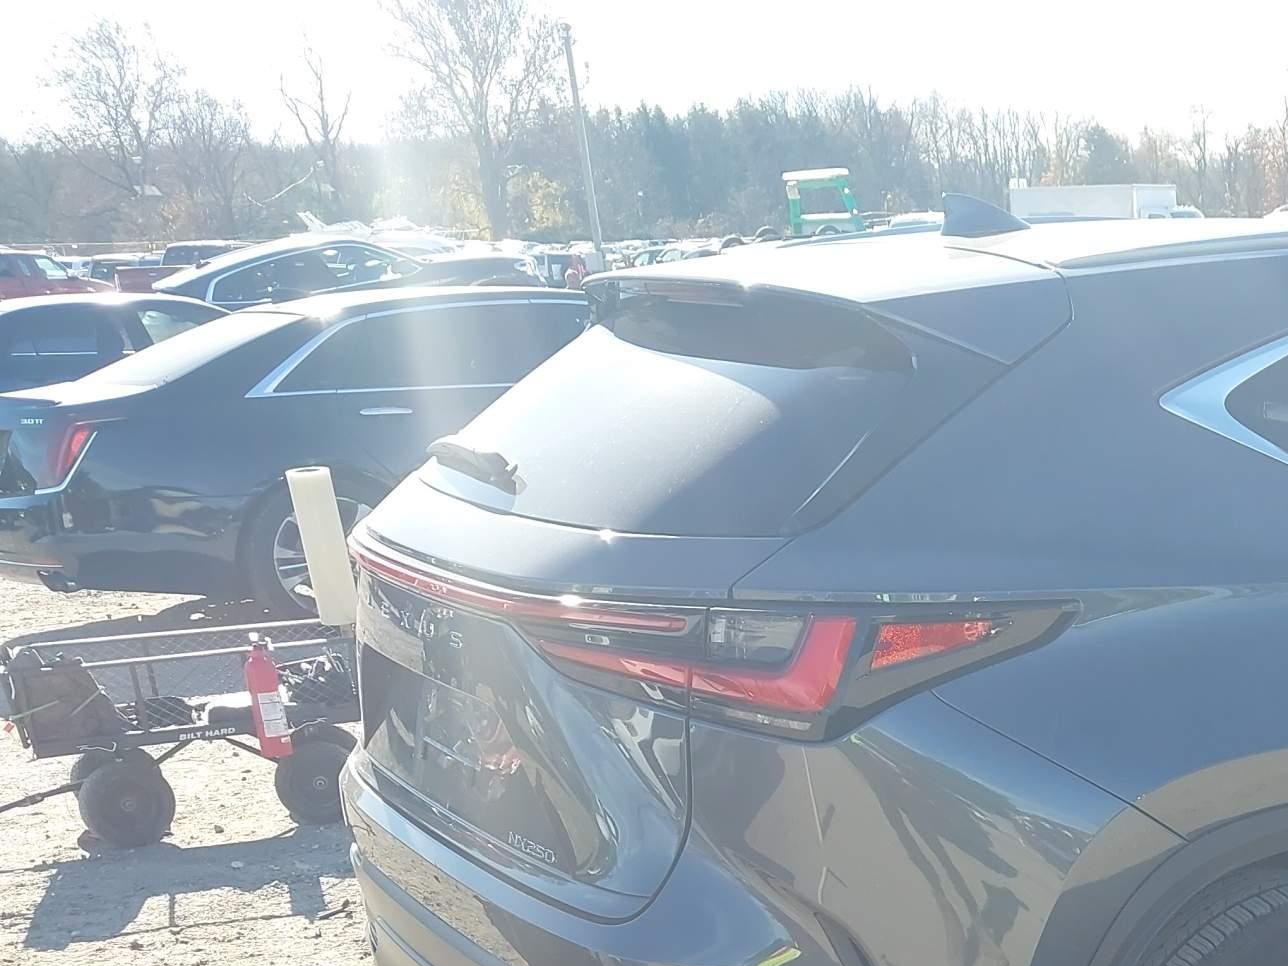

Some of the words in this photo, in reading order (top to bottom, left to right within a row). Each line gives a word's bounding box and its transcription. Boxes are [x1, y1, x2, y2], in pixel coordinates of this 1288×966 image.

[367, 592, 463, 649] LEXUS
[179, 731, 202, 741] BILT
[205, 727, 236, 737] HARD
